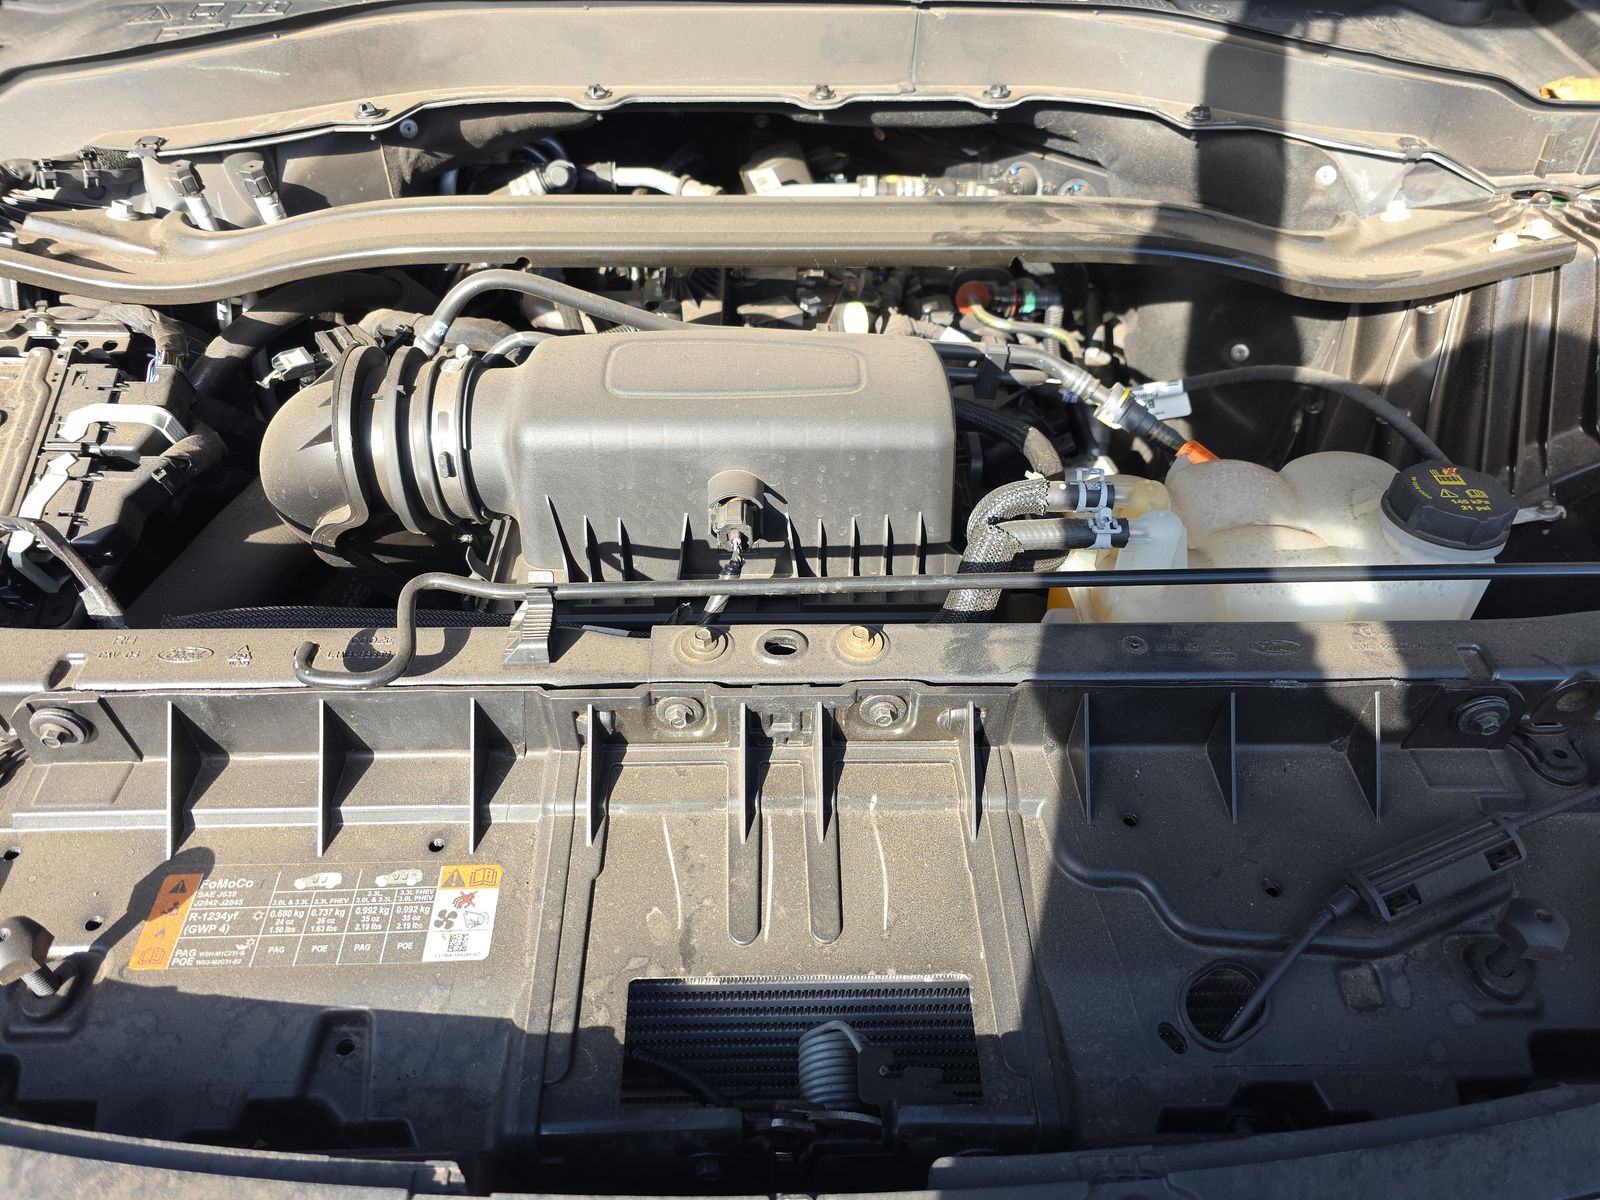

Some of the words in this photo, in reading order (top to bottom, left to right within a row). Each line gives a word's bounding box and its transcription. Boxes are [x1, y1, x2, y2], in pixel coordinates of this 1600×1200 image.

[200, 878, 254, 890] FoMoCo
[217, 890, 238, 898] J639
[414, 894, 434, 902] PHEV
[293, 908, 305, 919] kg
[310, 908, 334, 917] 0.737
[334, 907, 346, 918] kg
[355, 906, 378, 915] 0.992
[379, 906, 391, 916] kg
[396, 905, 419, 914] 0.992
[420, 904, 431, 915] kg
[188, 911, 239, 923] R-1234yf
[361, 915, 370, 923] 35
[402, 914, 411, 922] 35
[183, 924, 217, 936] (GWP
[218, 924, 231, 935] 4)
[269, 926, 284, 934] 1.50
[284, 925, 296, 933] lbs
[325, 924, 338, 932] lbs
[355, 923, 370, 931] 2.19
[371, 922, 382, 930] lbs
[396, 922, 411, 930] 2.19
[412, 921, 423, 929] lbs
[267, 945, 286, 954] PAG
[311, 944, 329, 952] POE
[354, 943, 371, 951] PAG
[397, 942, 414, 950] POE
[174, 949, 197, 957] PAG
[171, 957, 195, 966] POE
